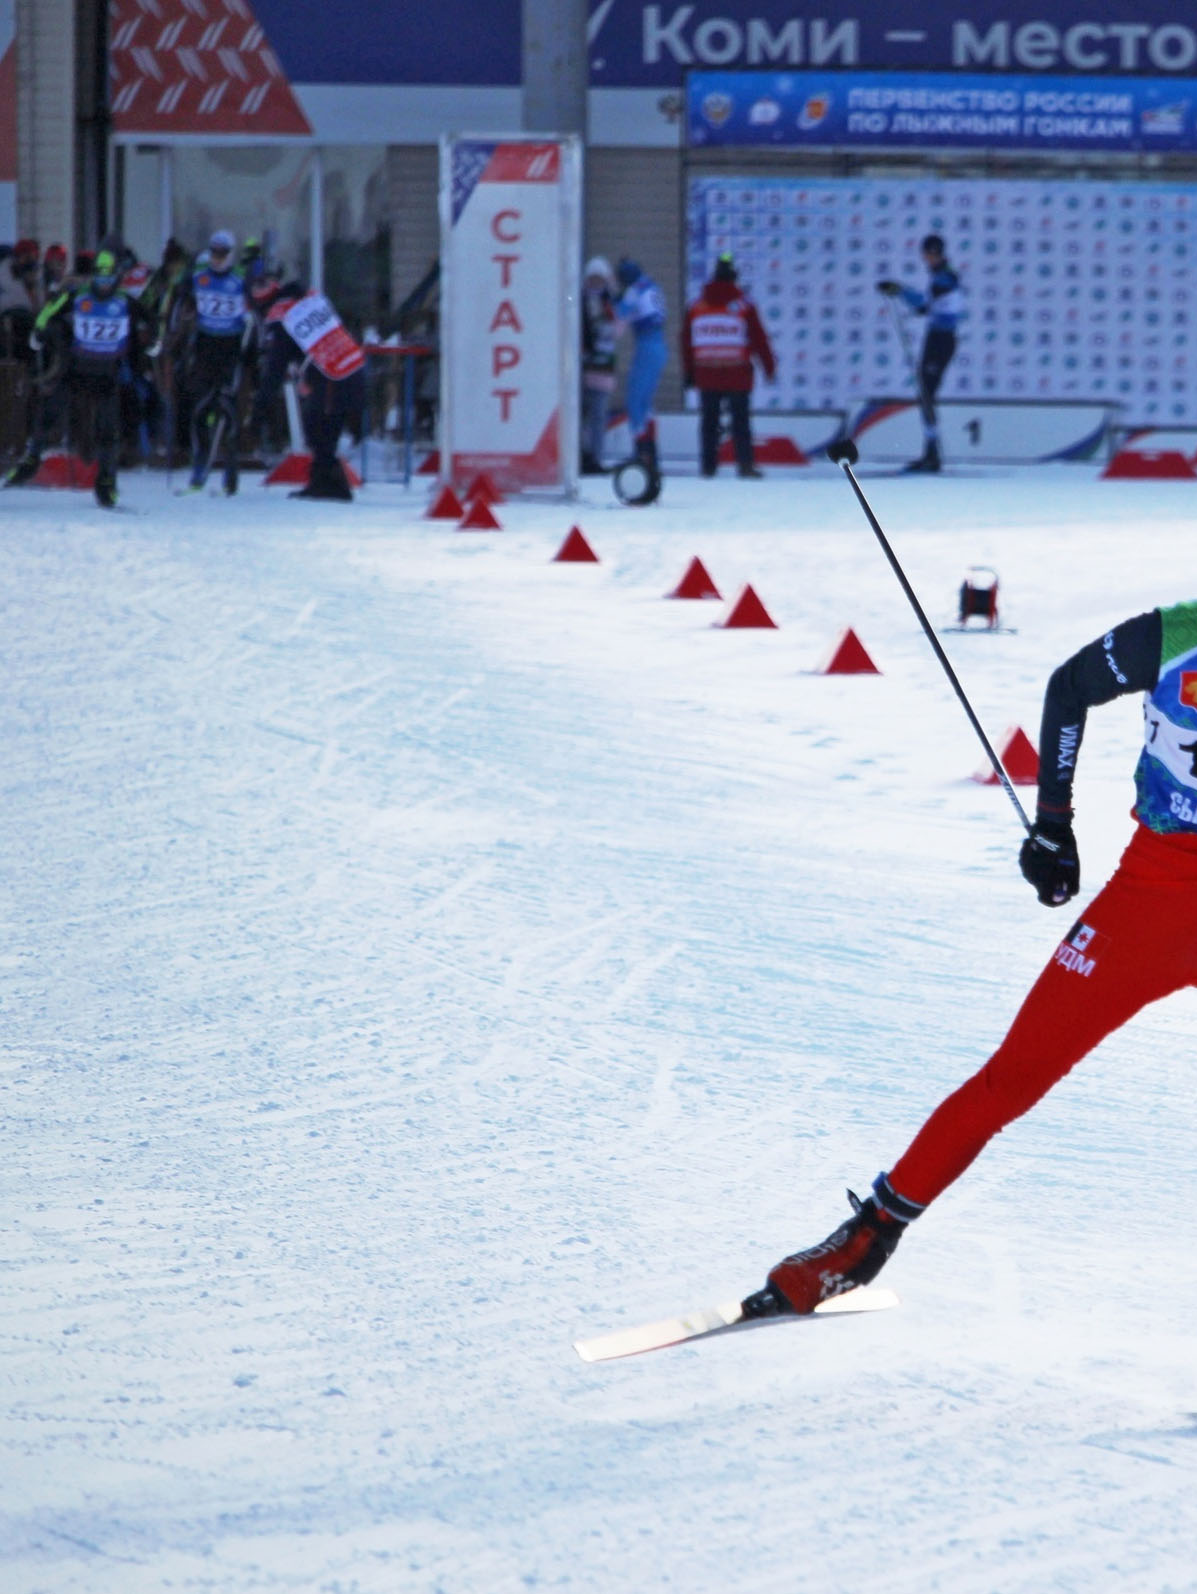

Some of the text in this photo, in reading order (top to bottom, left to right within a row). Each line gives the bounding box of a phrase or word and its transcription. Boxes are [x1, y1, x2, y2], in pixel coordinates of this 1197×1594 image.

[642, 5, 860, 65] Коми
[848, 88, 1133, 113] ПЕРВЕНСТВО РОССИИ
[847, 112, 889, 133] ПО
[489, 209, 523, 424] СТАРТ
[962, 419, 981, 446] 1
[1057, 724, 1079, 769] VMAX
